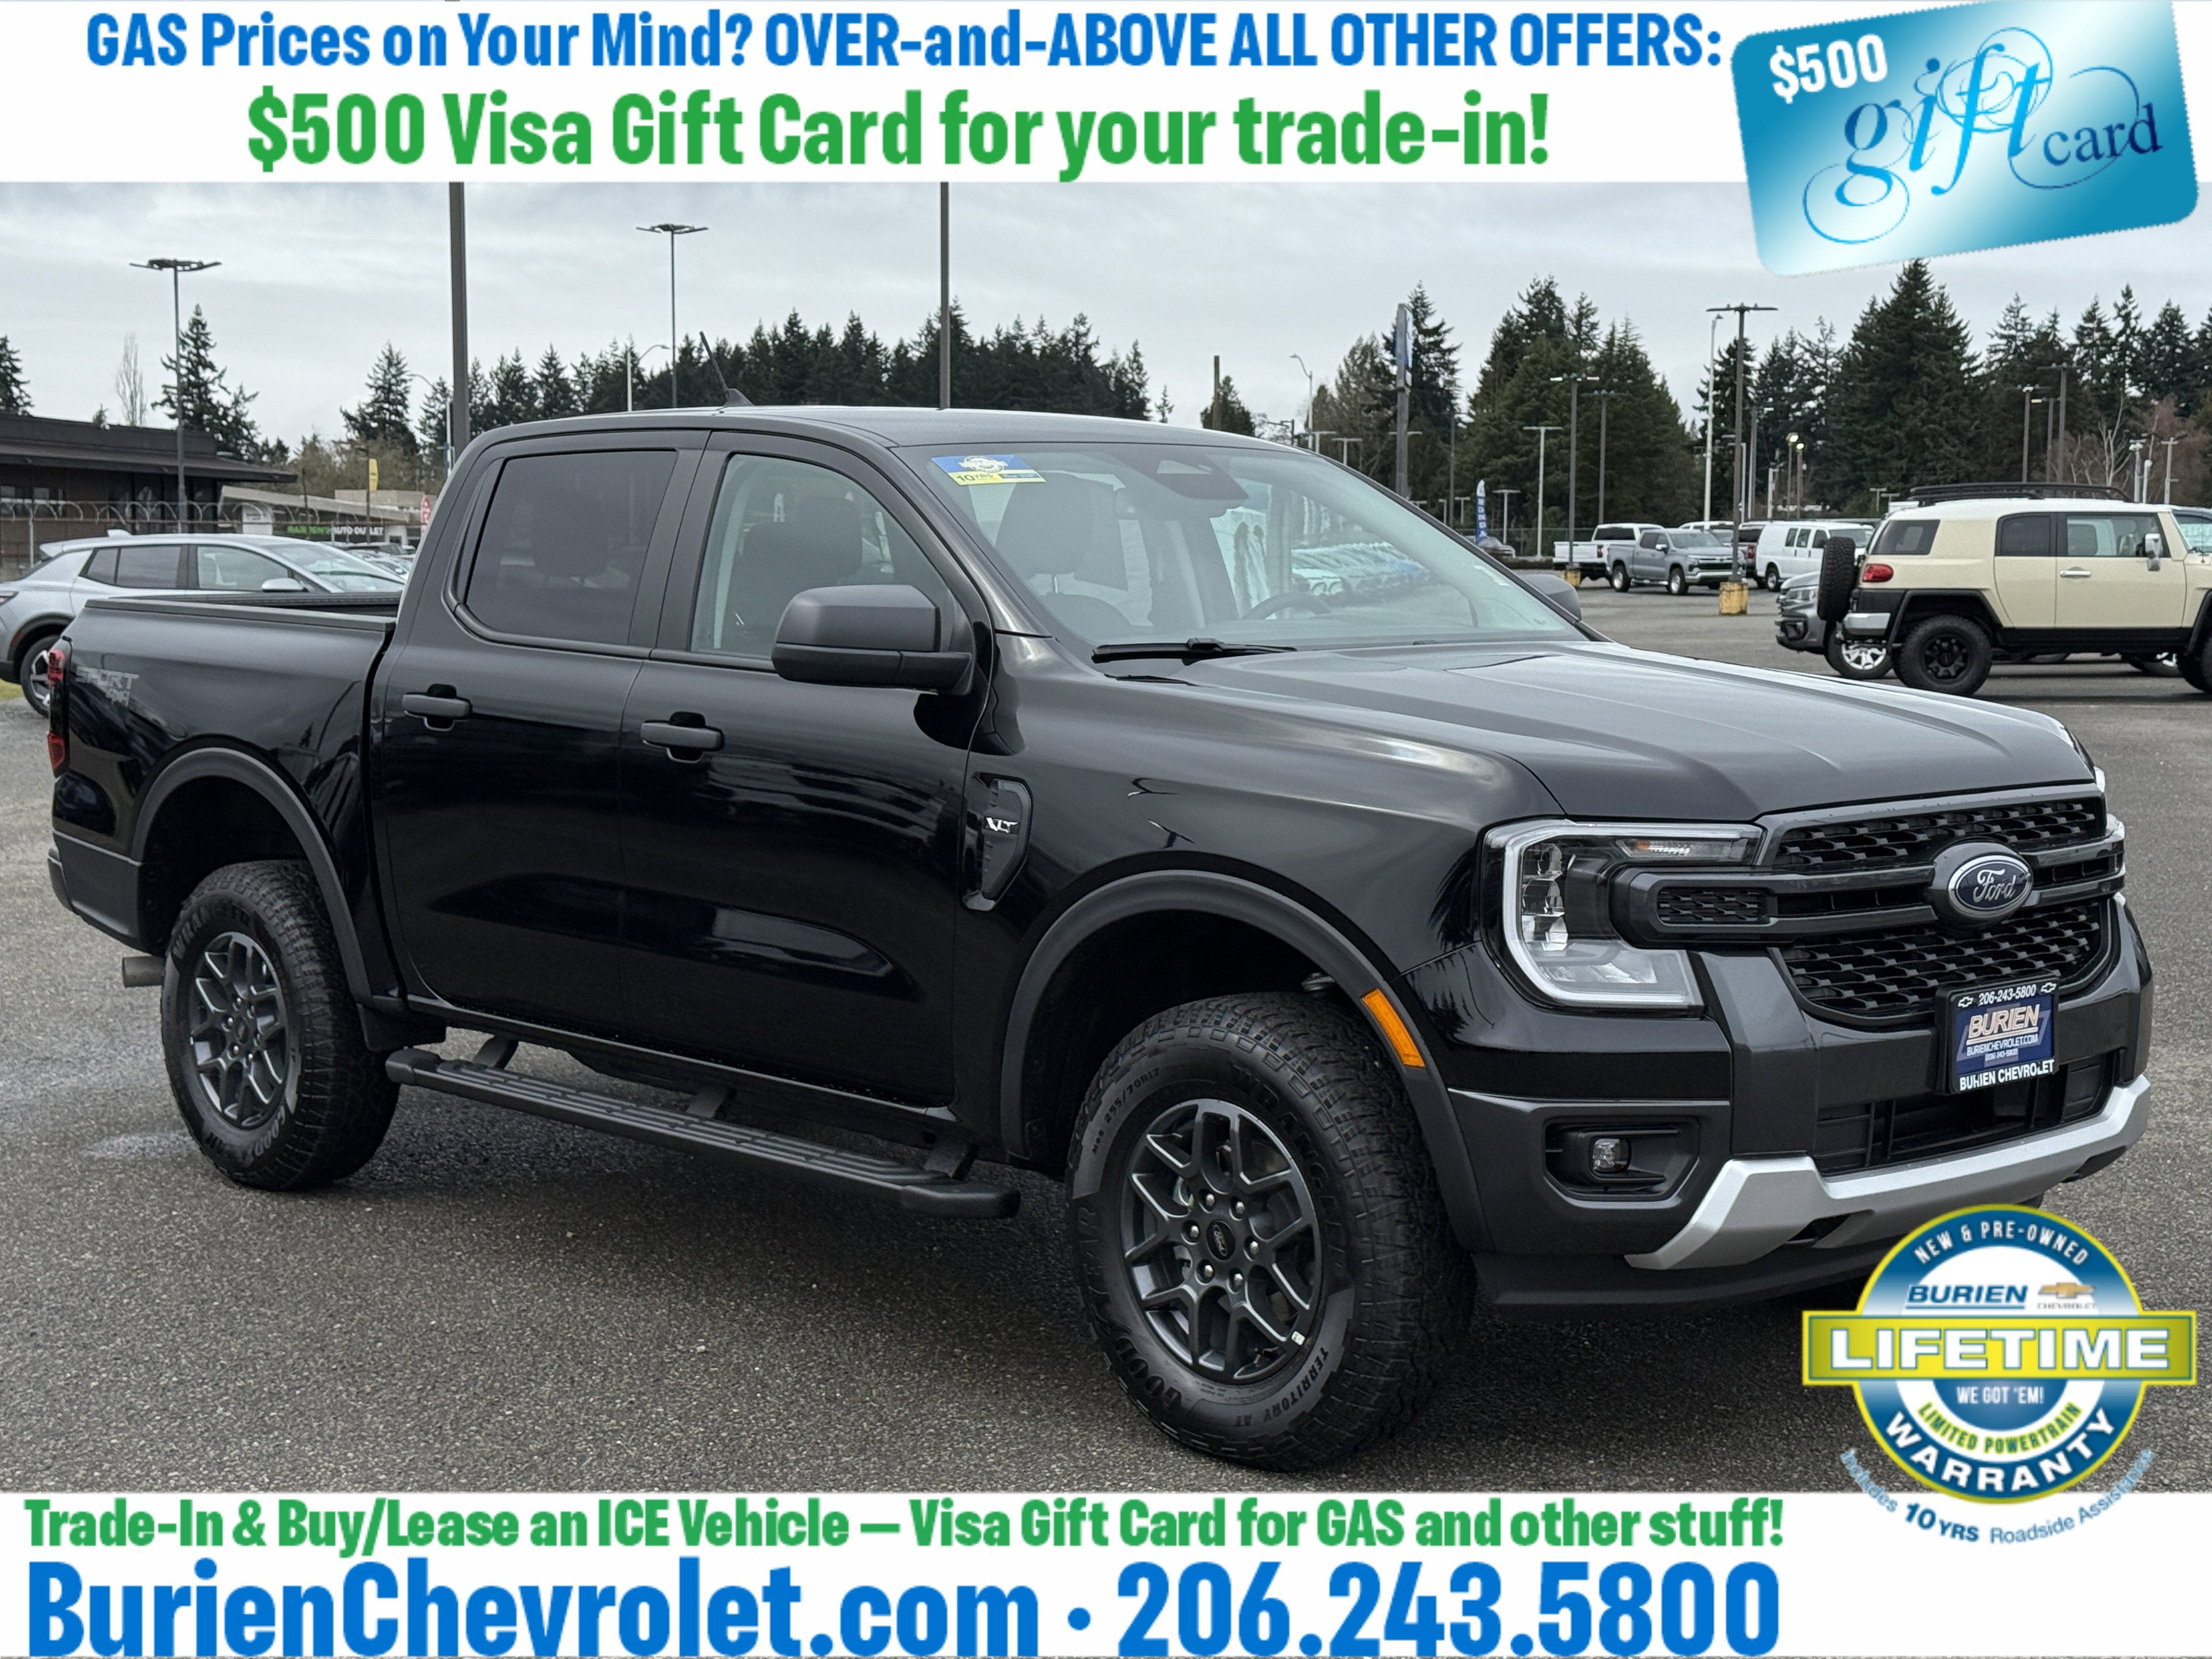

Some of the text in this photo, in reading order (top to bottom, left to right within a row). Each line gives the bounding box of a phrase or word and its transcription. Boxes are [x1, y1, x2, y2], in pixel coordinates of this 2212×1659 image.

[354, 526, 383, 535] OULET
[75, 665, 140, 690] SPORT
[985, 816, 1019, 834] XLT
[1972, 868, 2017, 904] Ford
[1978, 984, 2037, 1007] 206-243-5800
[1968, 1003, 2040, 1039] BURIEN
[1959, 1059, 2055, 1092] BURIEN CHEVROLET
[1104, 1066, 1160, 1124] 255/70R17
[1264, 1346, 1329, 1422] TERRITORY
